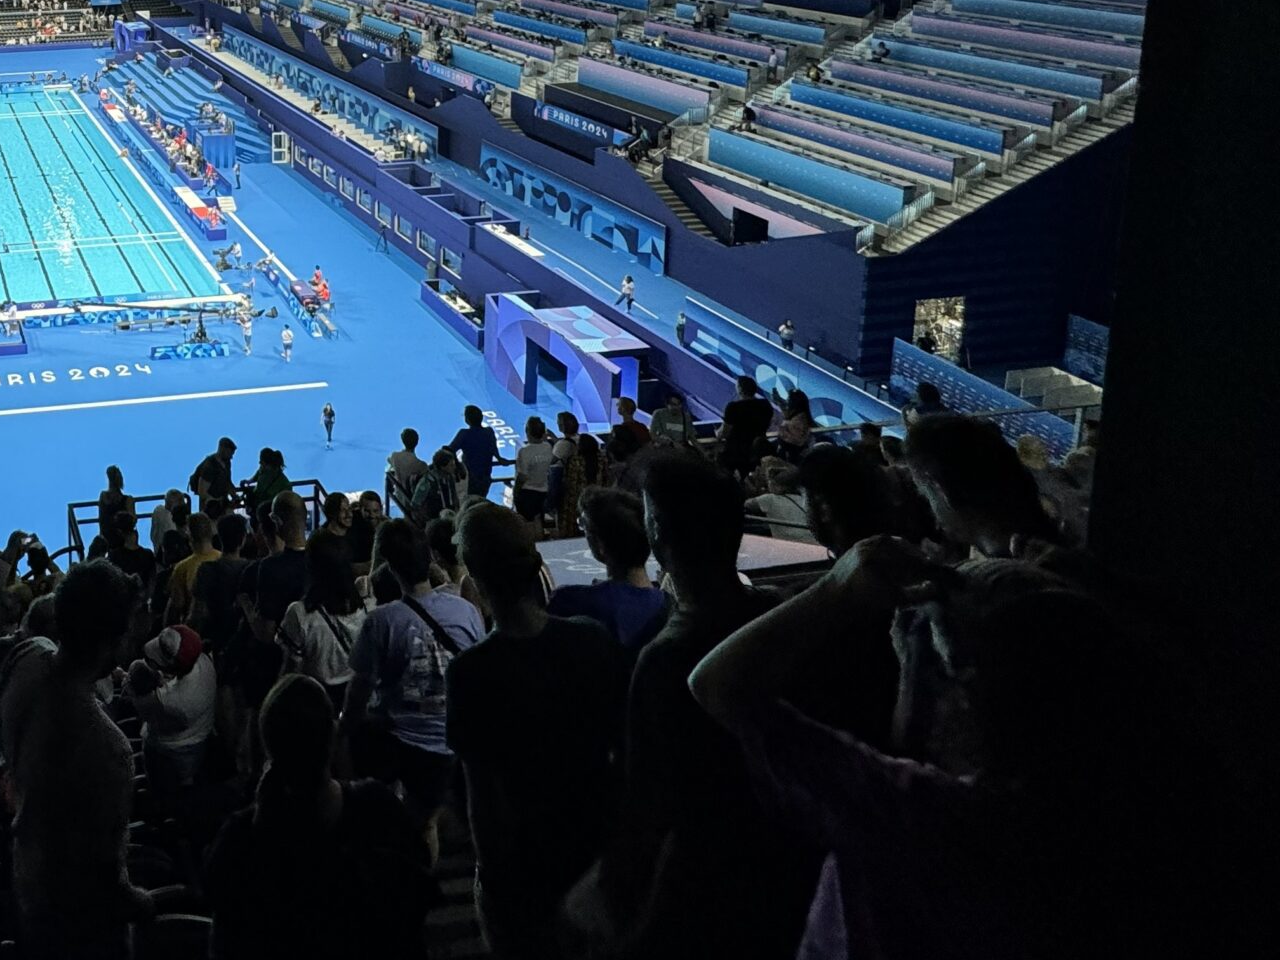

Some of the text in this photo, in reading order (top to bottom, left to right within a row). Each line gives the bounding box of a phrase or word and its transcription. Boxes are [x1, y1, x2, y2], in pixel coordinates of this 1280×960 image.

[553, 110, 608, 139] PARIS 2024
[68, 363, 152, 381] 2024
